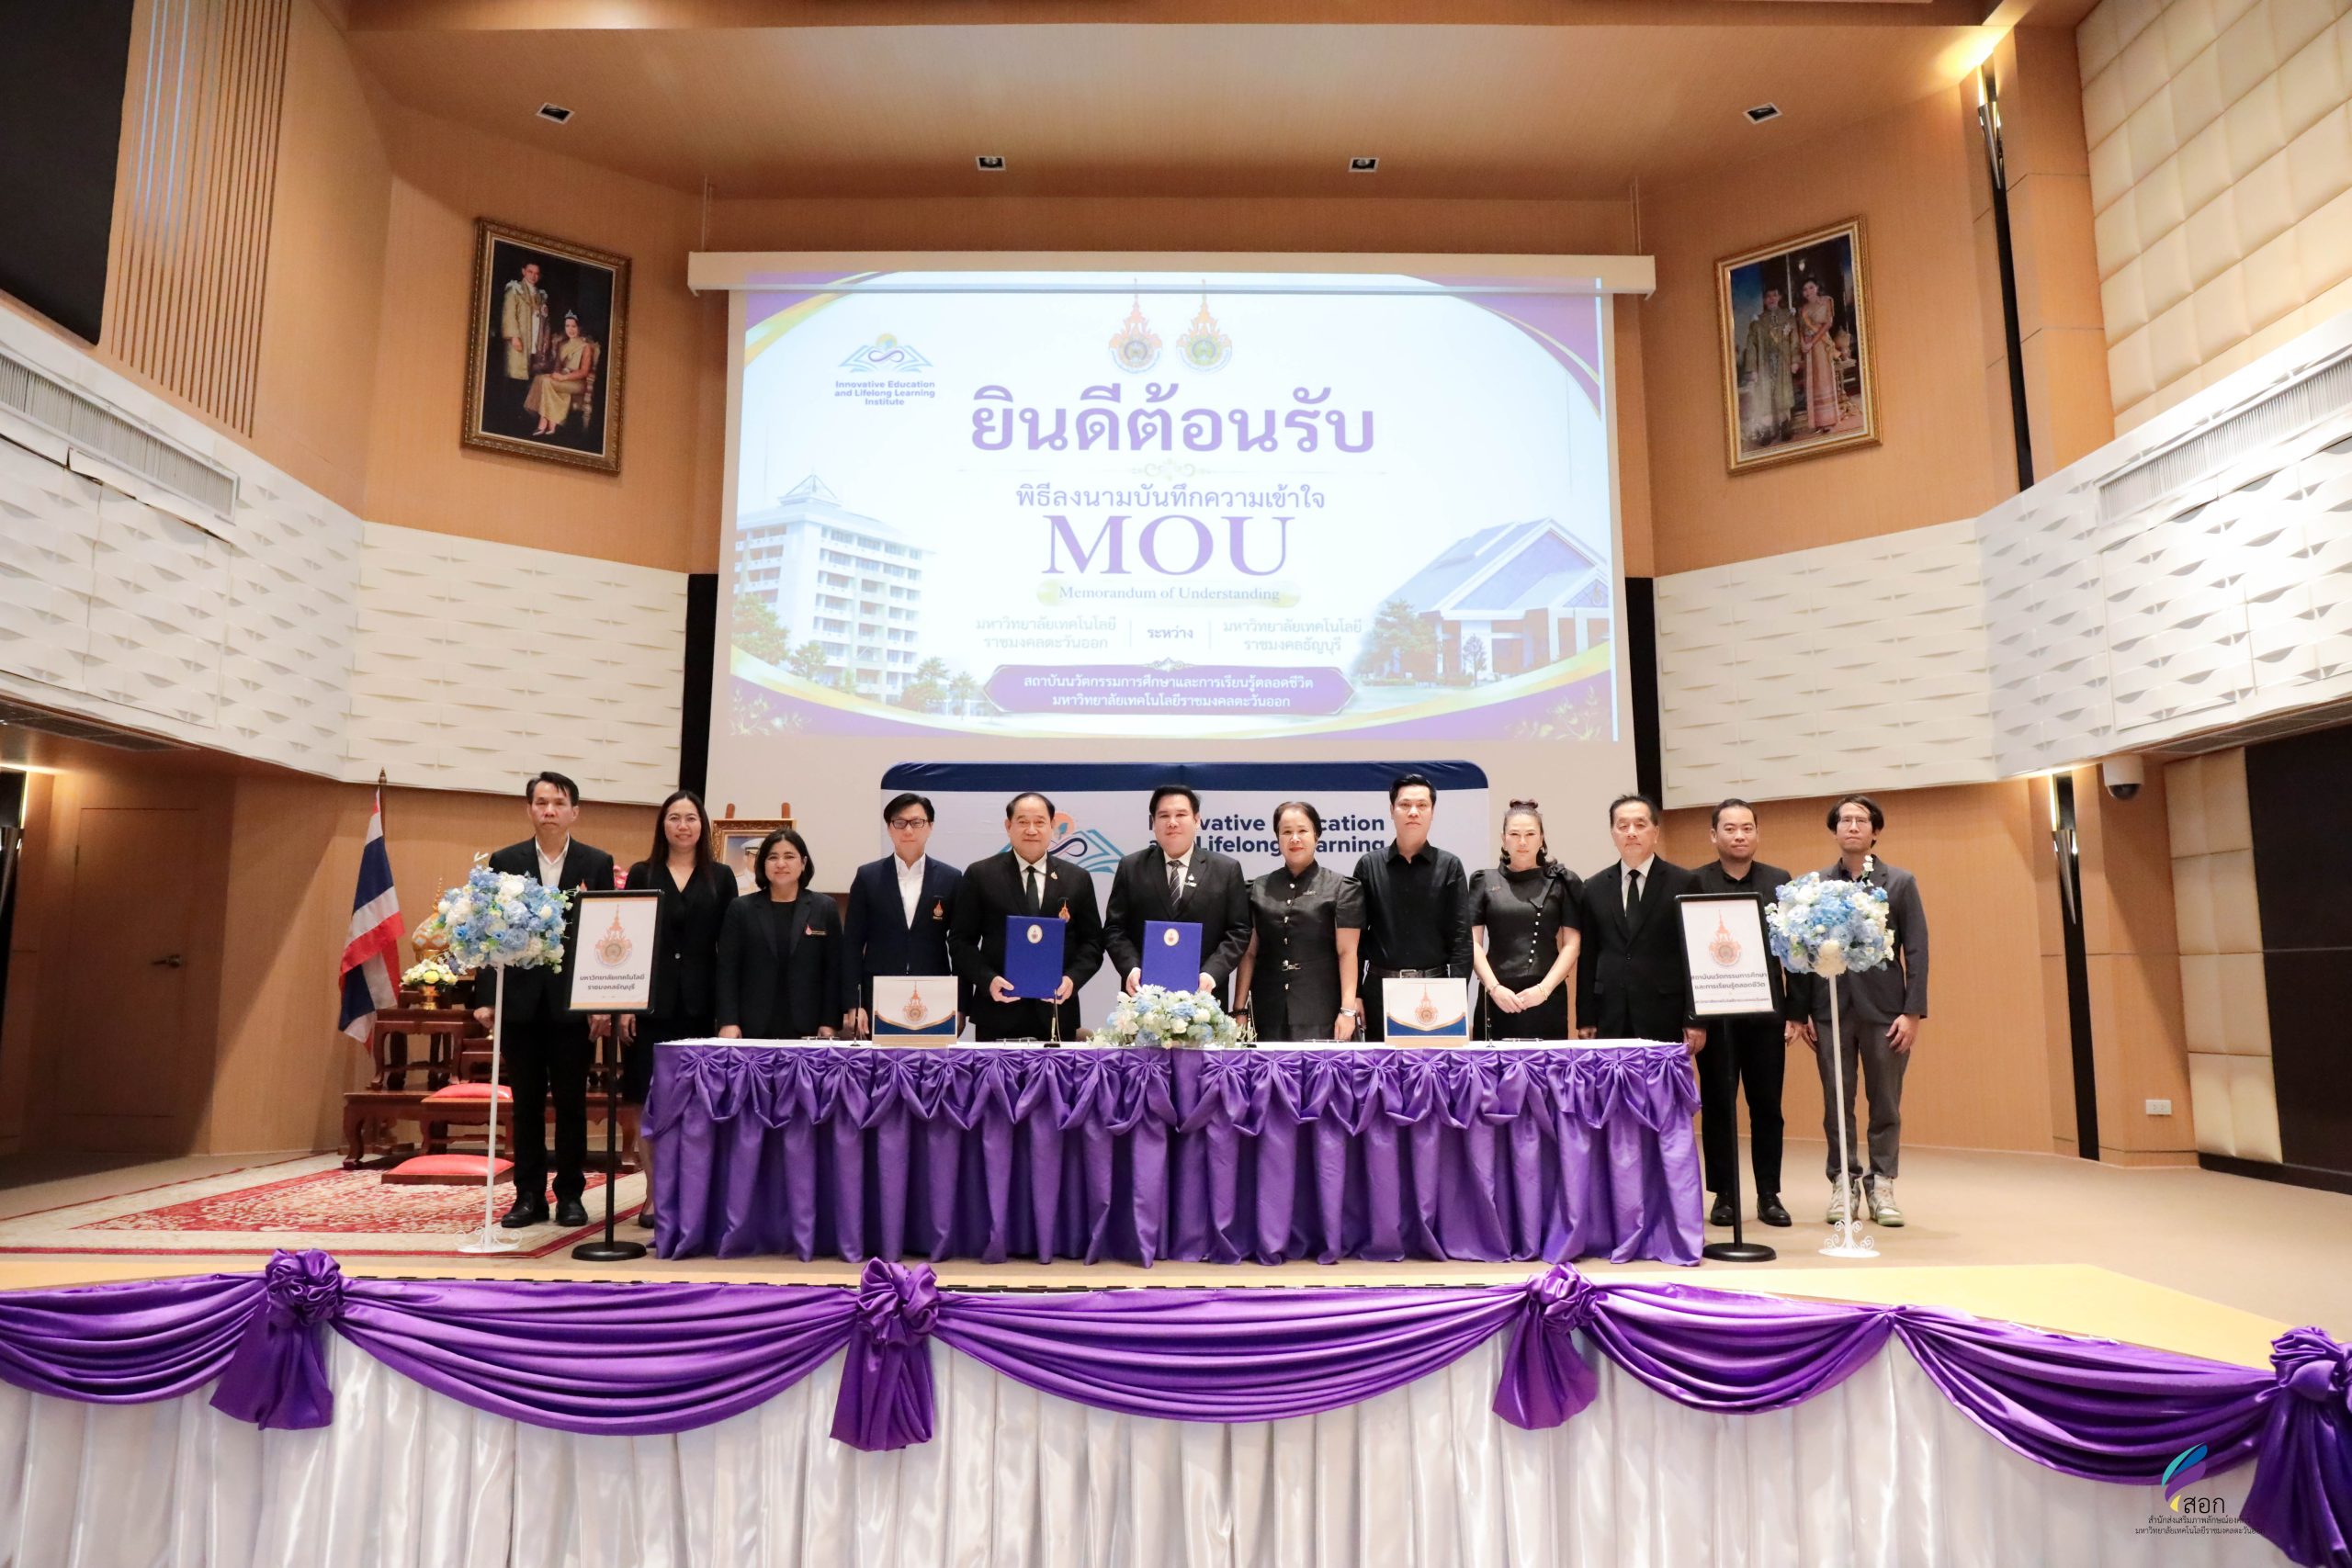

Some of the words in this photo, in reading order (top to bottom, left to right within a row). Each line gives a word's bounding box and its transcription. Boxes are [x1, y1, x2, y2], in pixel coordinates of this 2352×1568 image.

[835, 380, 885, 389] Innovative
[888, 380, 935, 389] Education
[854, 389, 892, 398] Lifelong
[894, 389, 935, 398] Learning
[865, 397, 905, 405] Institute
[971, 382, 1374, 453] ยินดีต้อนรับ
[1015, 482, 1326, 509] พิธีลงนามบันทึกความเข้าใจ
[1041, 513, 1296, 577] MOU
[1058, 586, 1157, 599] Memorandum
[1159, 586, 1175, 599] of
[1179, 587, 1281, 603] Understanding
[975, 615, 1117, 631] มหาวิทยาลัยเทคโนโลยี
[1223, 617, 1363, 634] มหาวิทยาลัยเทคโนโลยี
[1147, 625, 1193, 639] ระหว่าง
[983, 634, 1109, 649] ราชมงคลตะวันออก
[1243, 637, 1343, 656] ราชมงคลธัญบุรี
[1023, 673, 1314, 693] สถาบันนวัตกรรมการศึกษาและการเรียนรู้ตลอดชีวิต
[1052, 692, 1291, 708] มหาวิทยาลัยเทคโนโลยีราชมงคลตะวันออก
[1148, 814, 1266, 831] Ivative
[1320, 814, 1385, 831] cation
[1315, 835, 1385, 852] arning
